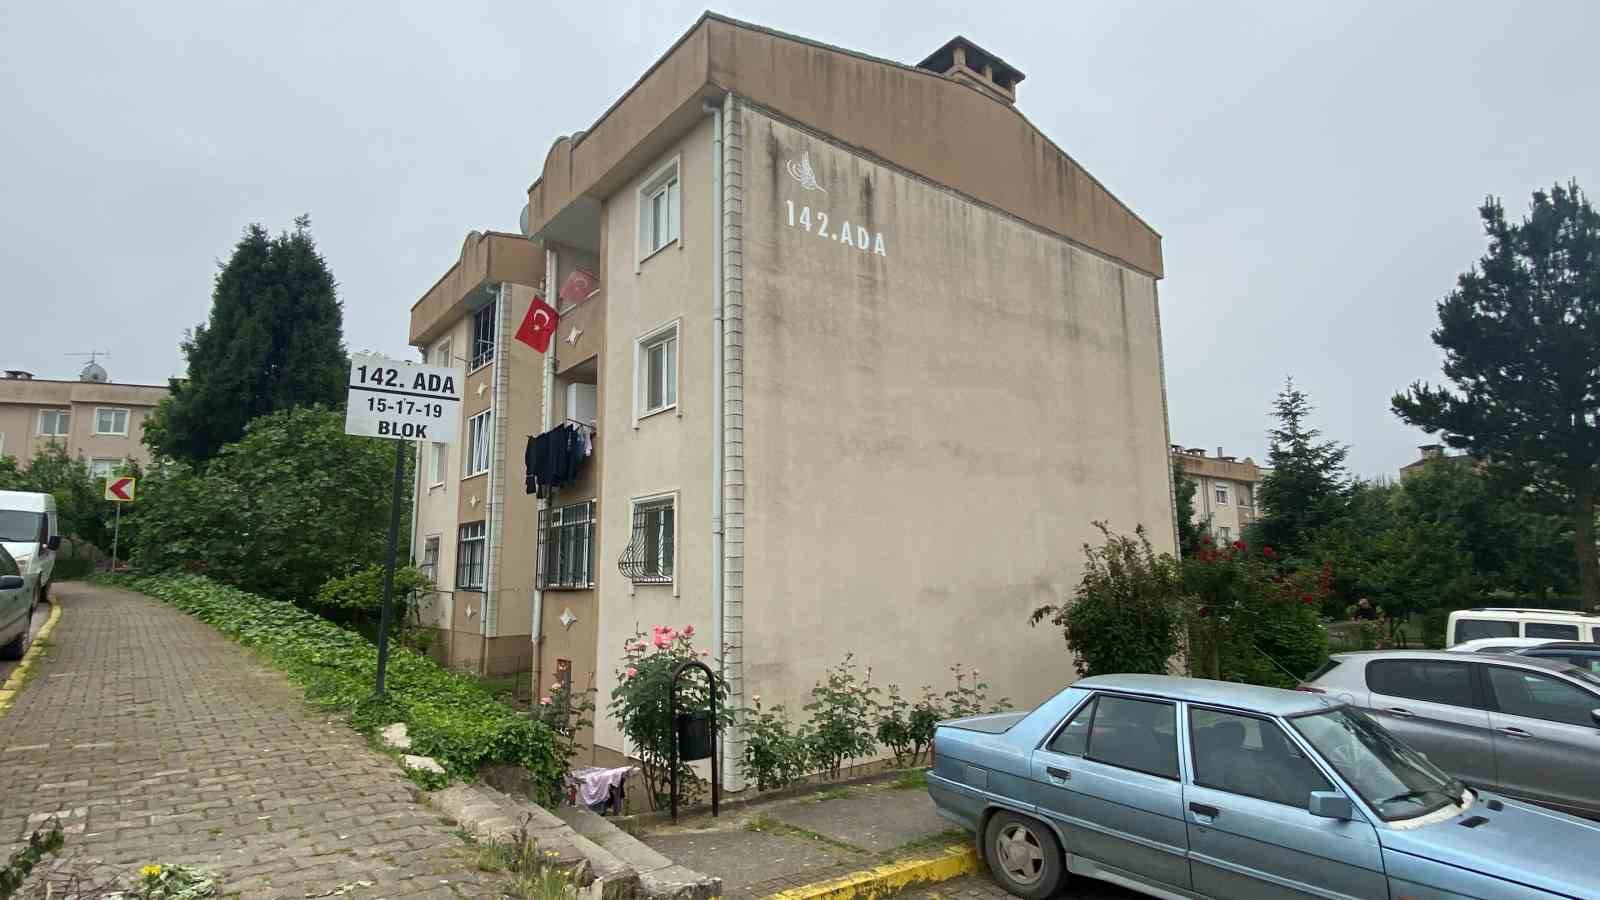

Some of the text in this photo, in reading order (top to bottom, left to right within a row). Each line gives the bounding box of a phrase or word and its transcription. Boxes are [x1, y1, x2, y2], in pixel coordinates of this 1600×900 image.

[357, 365, 455, 394] 142. ADA
[367, 396, 443, 418] 15-17-19
[378, 420, 428, 439] BLOK
